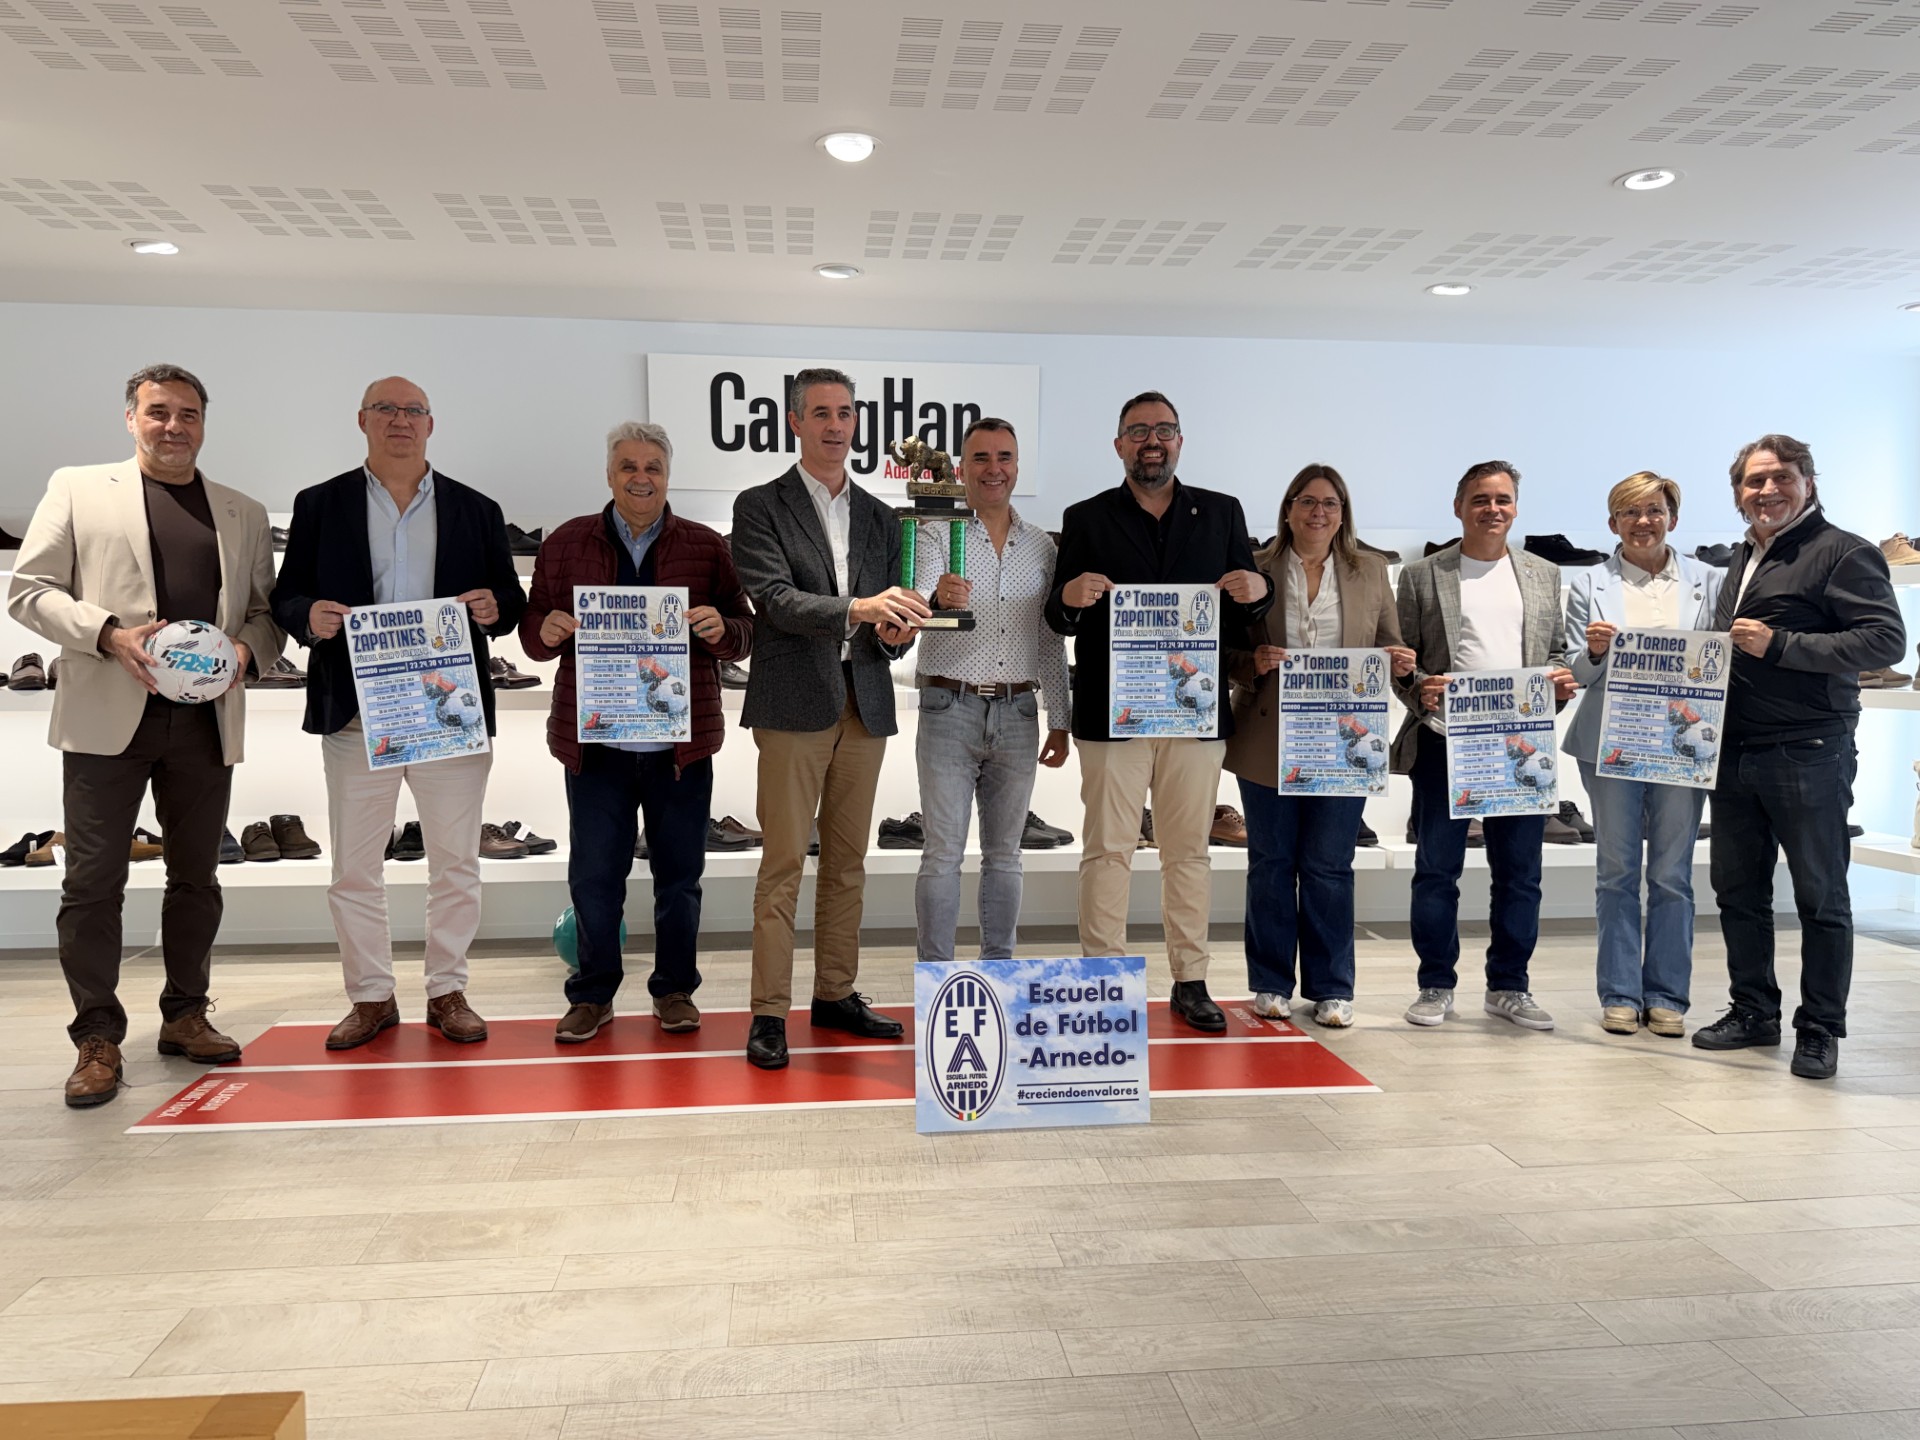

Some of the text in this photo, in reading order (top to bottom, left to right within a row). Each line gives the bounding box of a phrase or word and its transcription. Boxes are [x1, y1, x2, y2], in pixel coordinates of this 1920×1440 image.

[710, 372, 981, 475] CalgHan
[579, 613, 647, 630] ZAPATINES
[1114, 610, 1178, 627] ZAPATINES
[352, 627, 427, 653] ZAPATINES
[1612, 652, 1685, 673] ZAPATINES
[1284, 673, 1348, 690] ZAPATINES
[1449, 694, 1514, 714] ZAPATINES
[1028, 979, 1124, 1004] Escuela
[946, 1009, 986, 1038] E F
[1015, 1010, 1138, 1036] de Fútbol
[946, 1033, 988, 1072] A
[1019, 1042, 1136, 1068] -Arnedo-
[946, 1081, 988, 1090] ARNEDO
[1017, 1085, 1139, 1100] #creciendoenvalores
